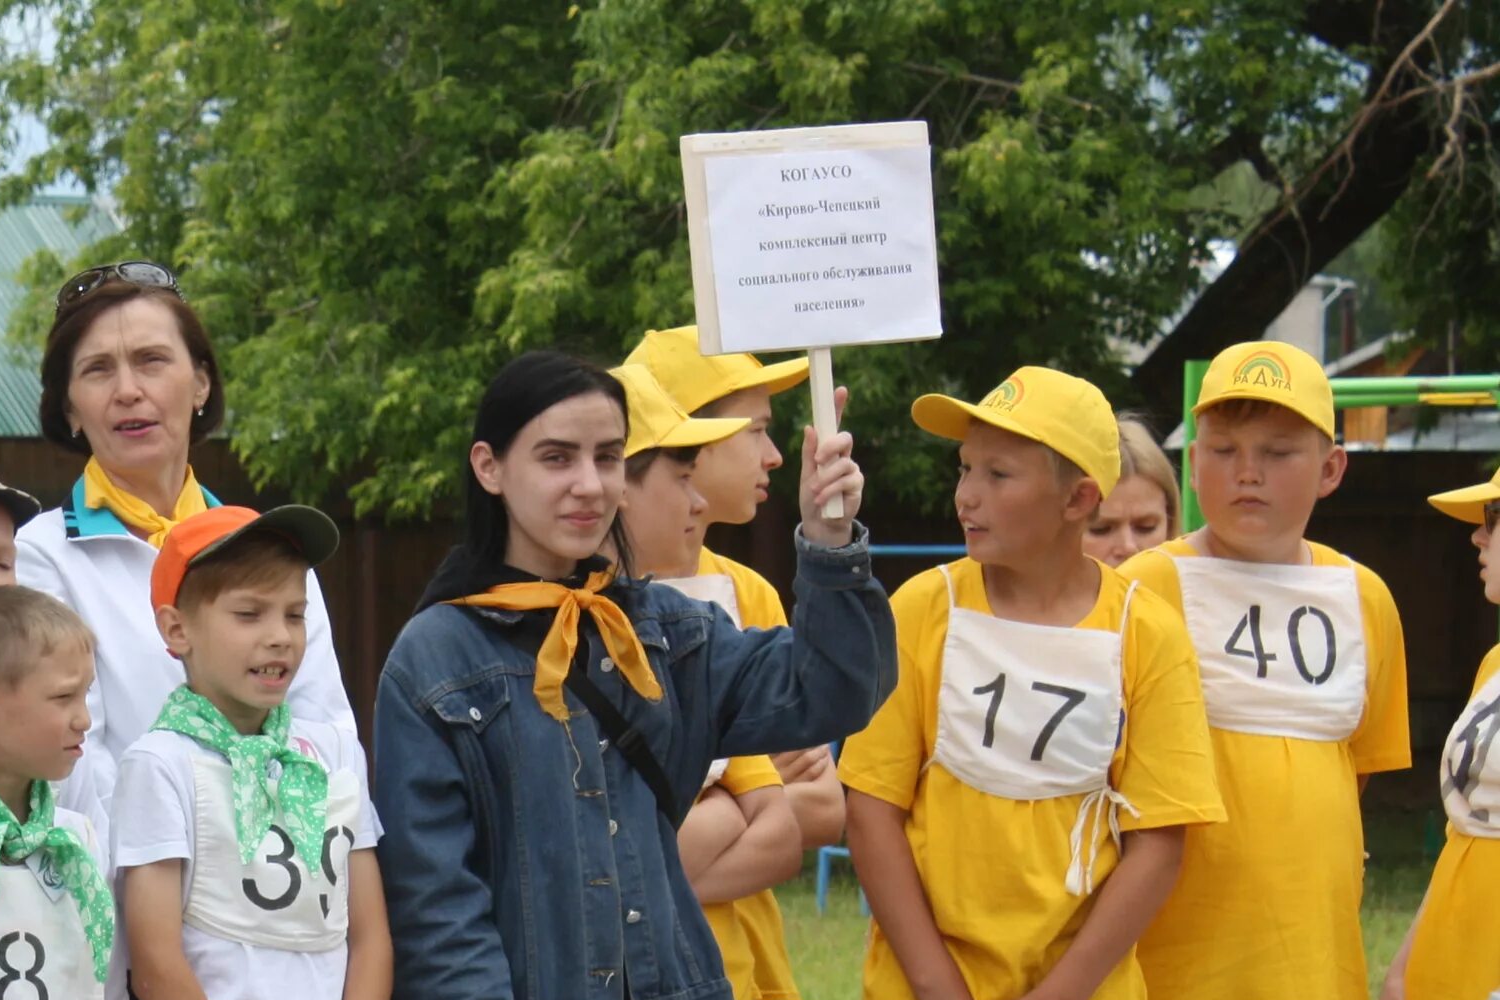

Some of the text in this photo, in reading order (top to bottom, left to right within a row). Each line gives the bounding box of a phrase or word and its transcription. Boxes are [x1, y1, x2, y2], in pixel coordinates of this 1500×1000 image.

[779, 164, 853, 183] КОГАУСО
[758, 196, 881, 219] «Кирово-Чепецкий
[758, 231, 888, 252] комплексный центр
[738, 262, 913, 288] социального обслуживания
[793, 296, 866, 314] населения»
[1224, 605, 1338, 686] 40
[972, 672, 1087, 762] 17
